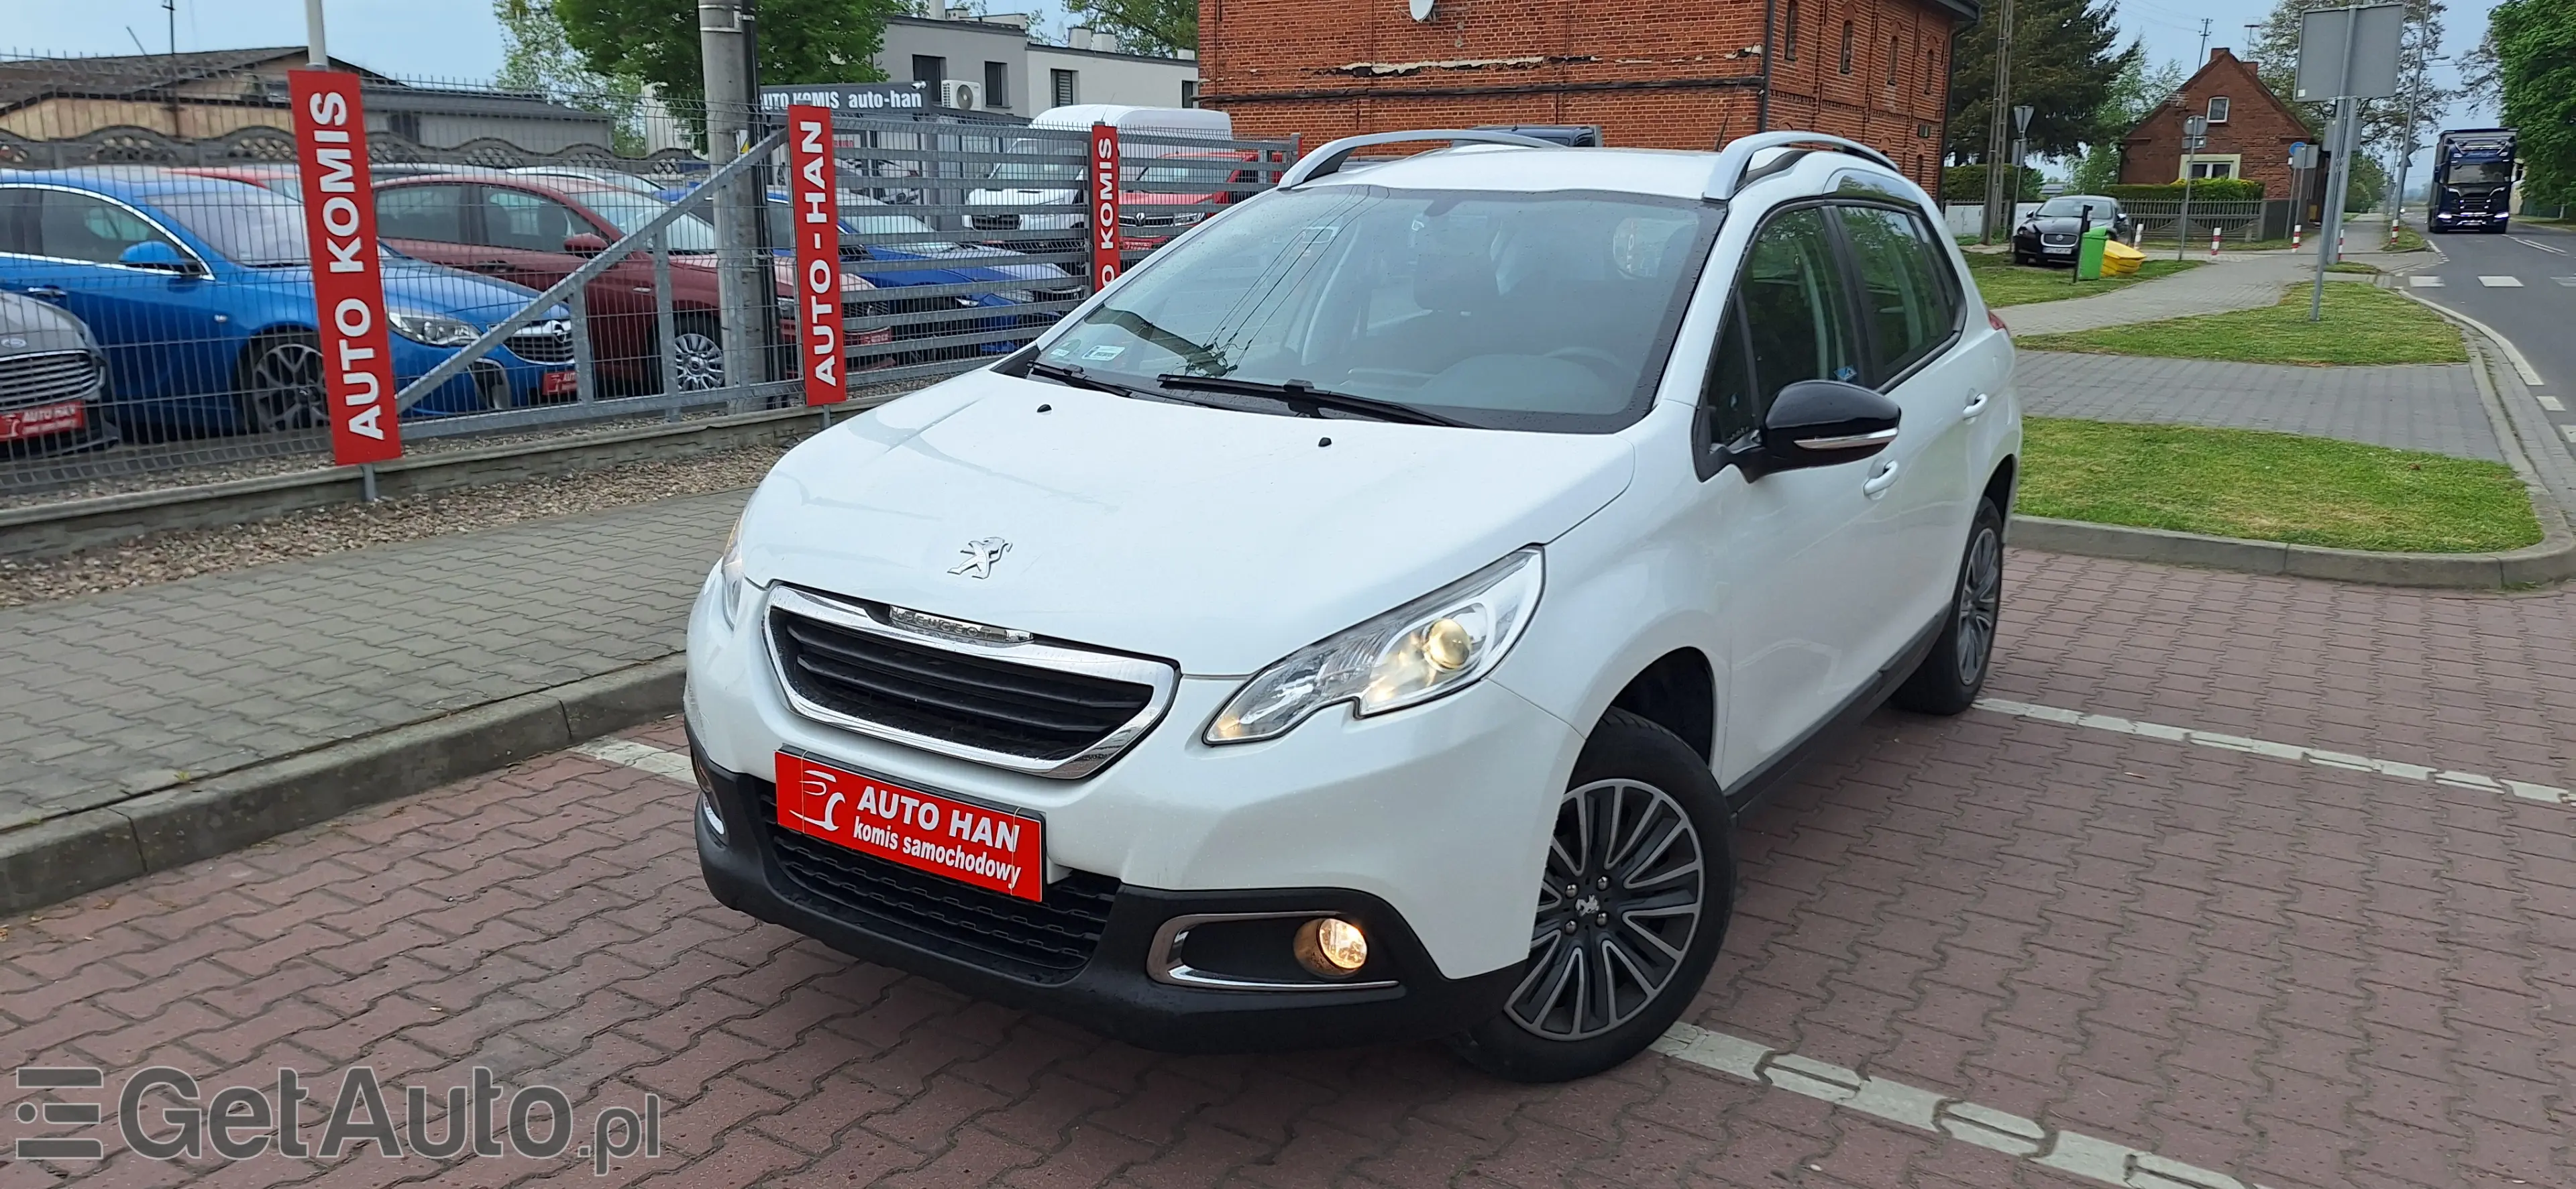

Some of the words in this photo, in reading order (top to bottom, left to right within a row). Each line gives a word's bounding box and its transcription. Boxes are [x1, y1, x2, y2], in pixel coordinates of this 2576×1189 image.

[848, 90, 922, 109] auto-han
[309, 92, 365, 273] KOMIS
[1098, 137, 1114, 249] KOMIS
[335, 298, 385, 441] AUTO
[904, 610, 993, 639] PEUGEOT
[853, 815, 899, 850] komis
[902, 836, 1022, 889] samochodowy
[857, 785, 940, 831] AUTO
[949, 809, 1020, 853] HAN
